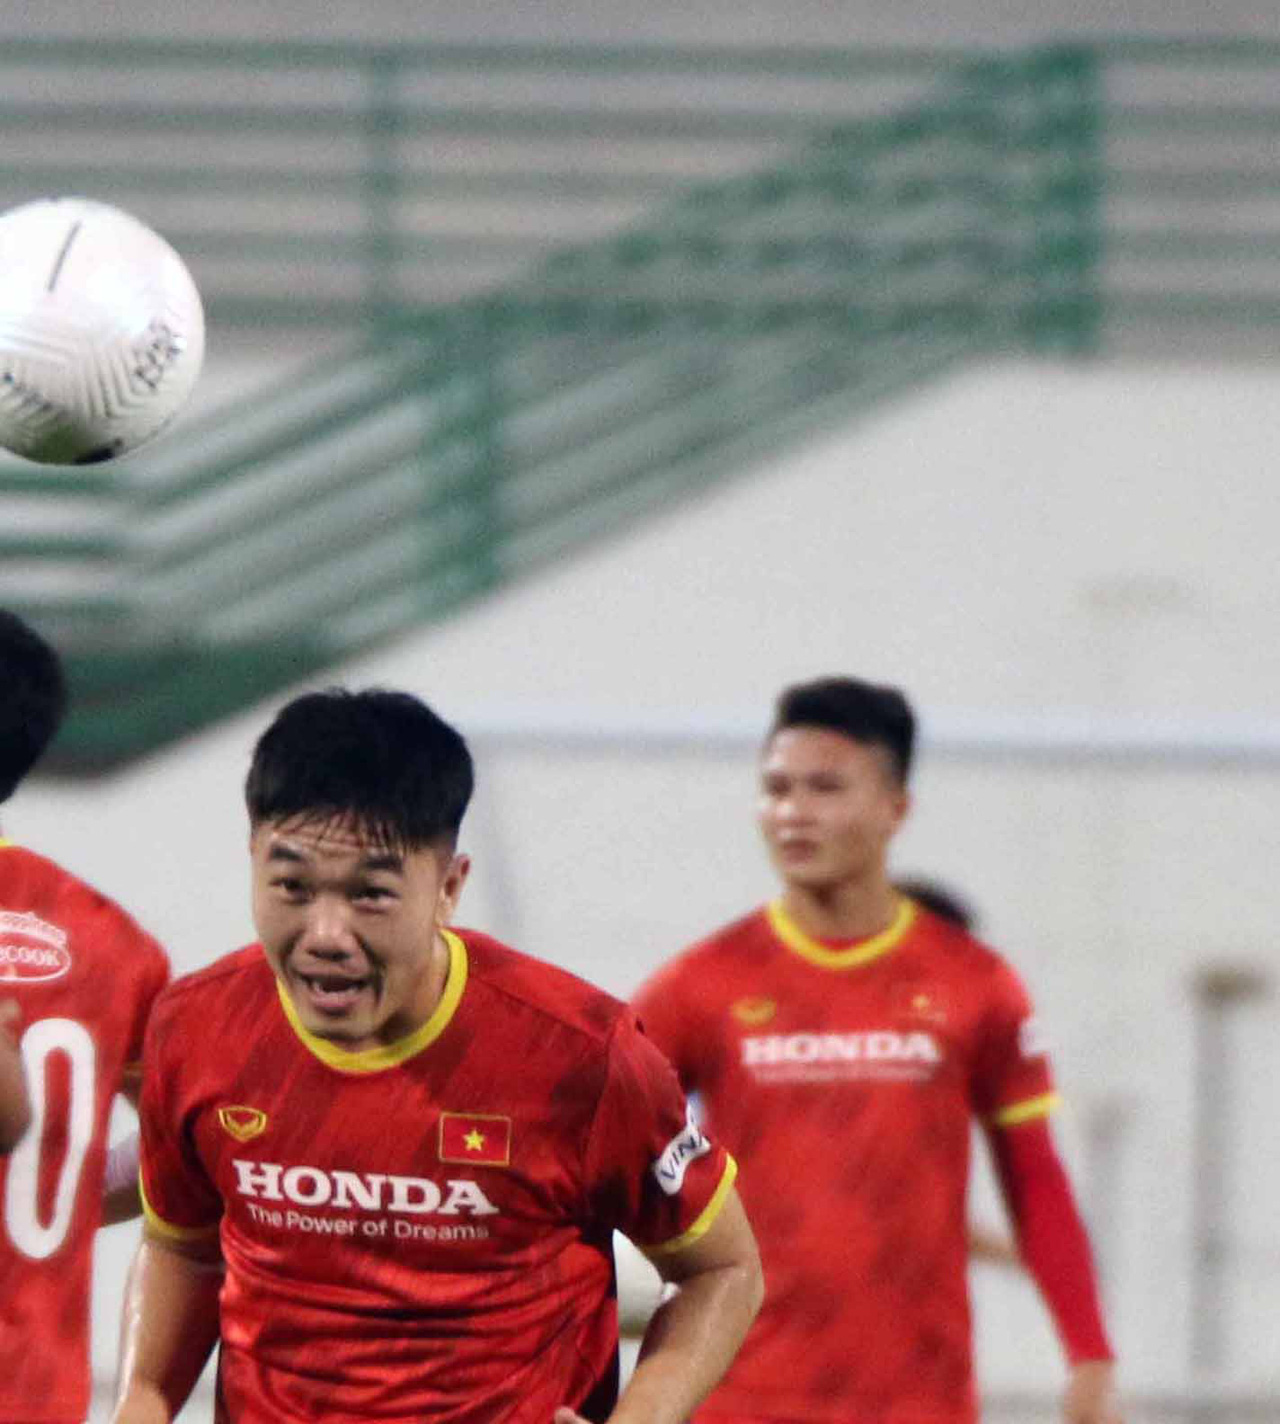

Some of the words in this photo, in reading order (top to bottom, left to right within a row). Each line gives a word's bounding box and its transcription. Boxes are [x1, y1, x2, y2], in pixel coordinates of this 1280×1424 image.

[741, 1031, 941, 1066] HONDA
[232, 1159, 500, 1217] HONDA
[247, 1203, 284, 1228] The
[286, 1210, 358, 1237] Power
[362, 1217, 389, 1239] of
[394, 1219, 490, 1242] Dreams
